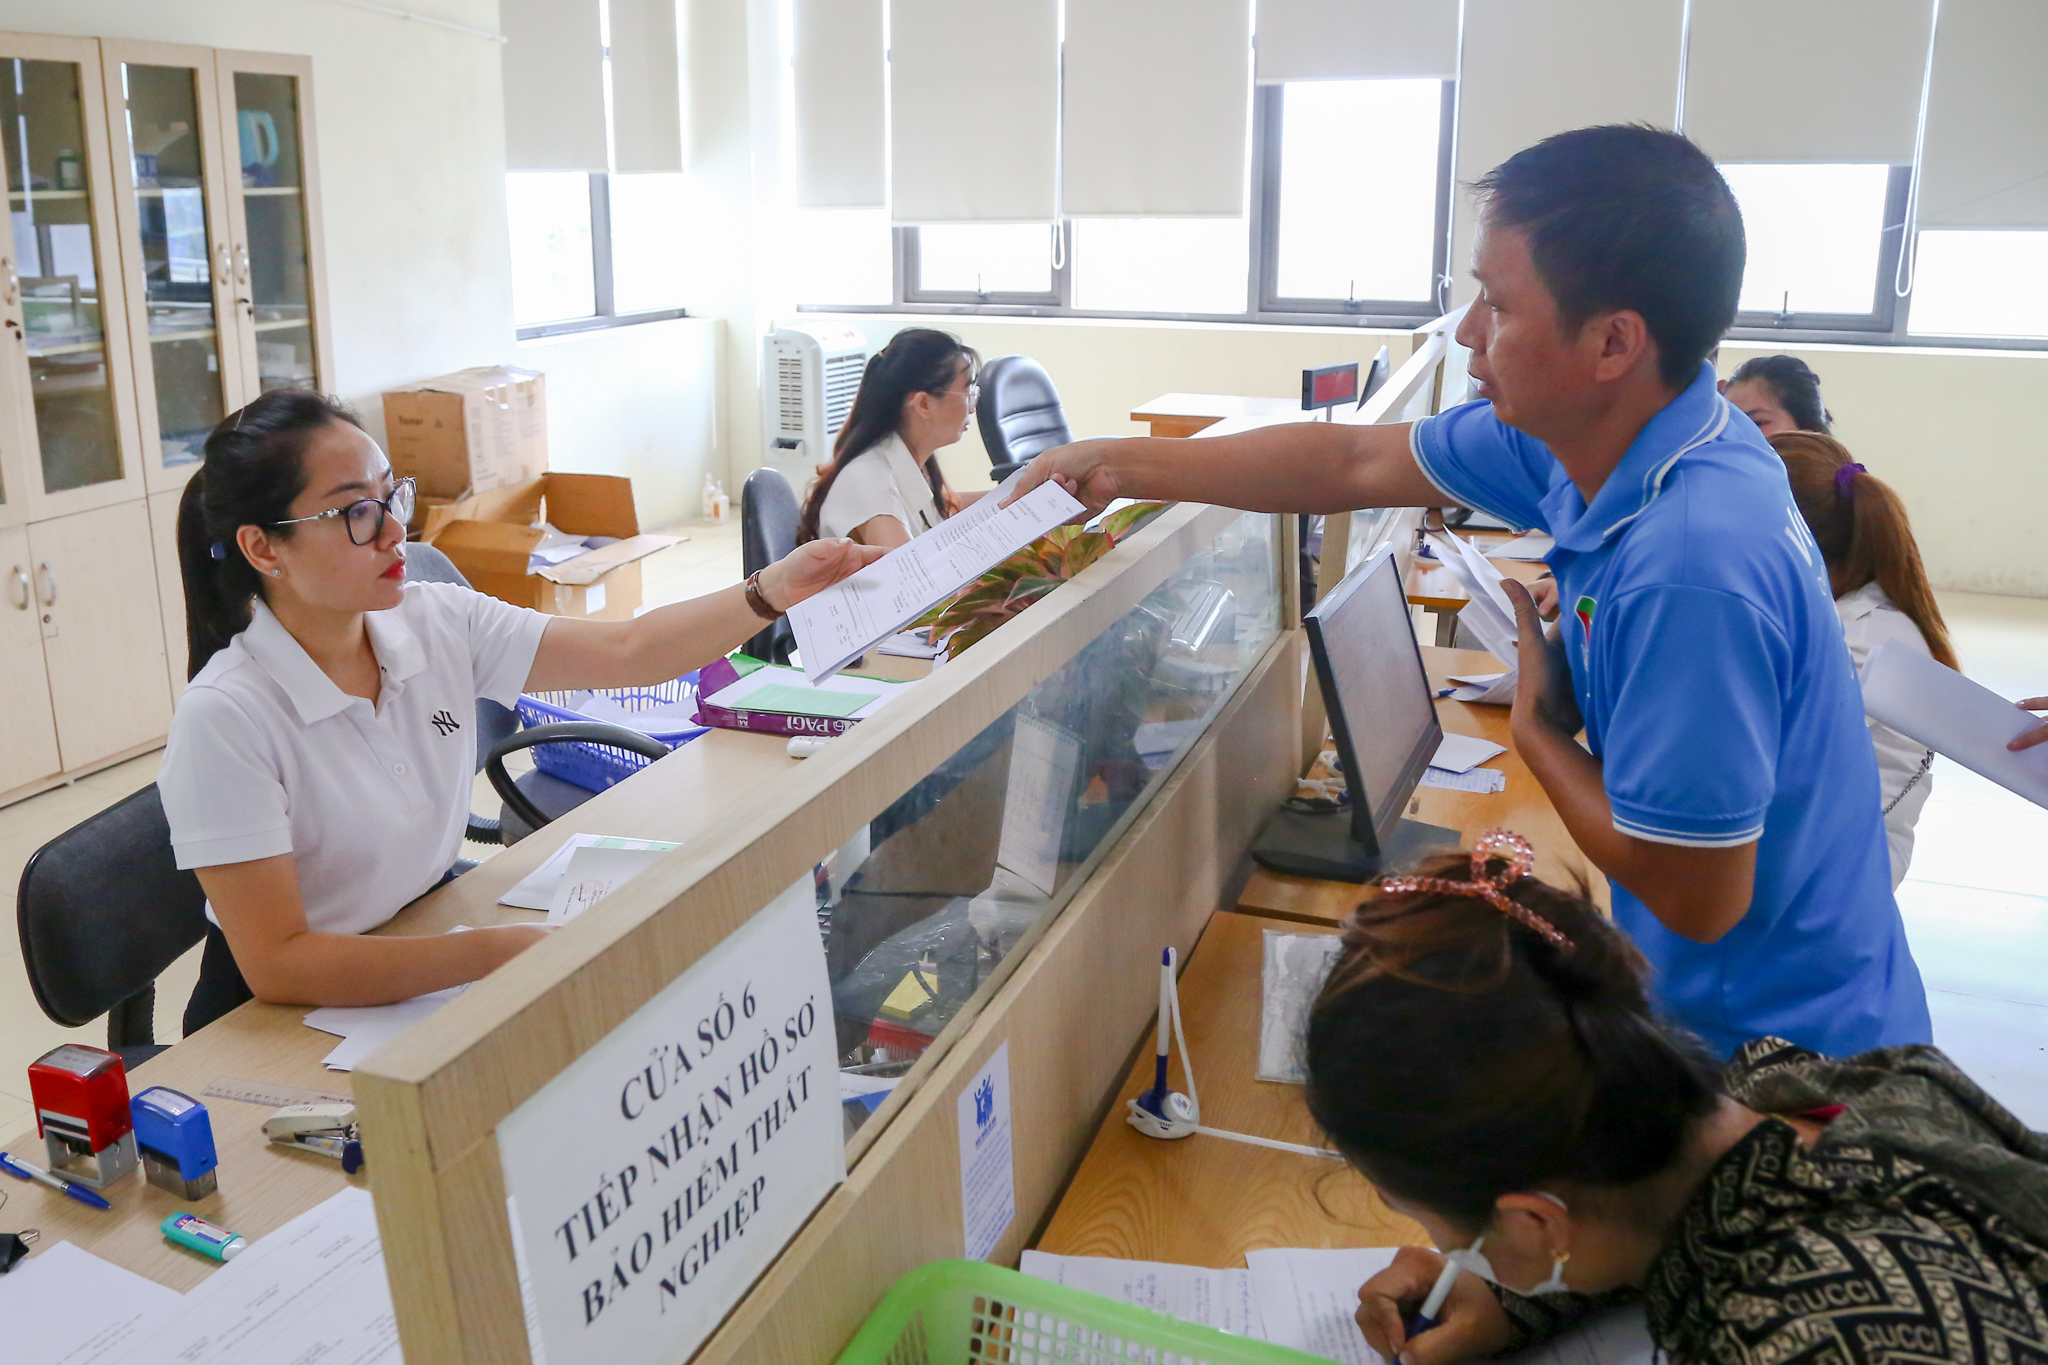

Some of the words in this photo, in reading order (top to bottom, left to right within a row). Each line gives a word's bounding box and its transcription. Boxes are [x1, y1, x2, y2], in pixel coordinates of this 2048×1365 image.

[786, 715, 830, 733] PAGI
[620, 1042, 693, 1121] CỬA
[697, 991, 735, 1059] SỐ
[743, 980, 756, 1019] 6
[554, 1172, 638, 1262] TIẾP
[646, 1074, 733, 1185] NHẬN
[739, 1028, 779, 1096] HỒ
[784, 994, 815, 1054] SƠ
[582, 1231, 653, 1328] BẢO
[662, 1139, 739, 1246] HIỂM
[745, 1064, 811, 1156] THẤT
[658, 1174, 766, 1316] NGHIỆP
[1783, 1278, 1880, 1316] GUCCI
[1855, 1323, 1944, 1355] GUCCI
